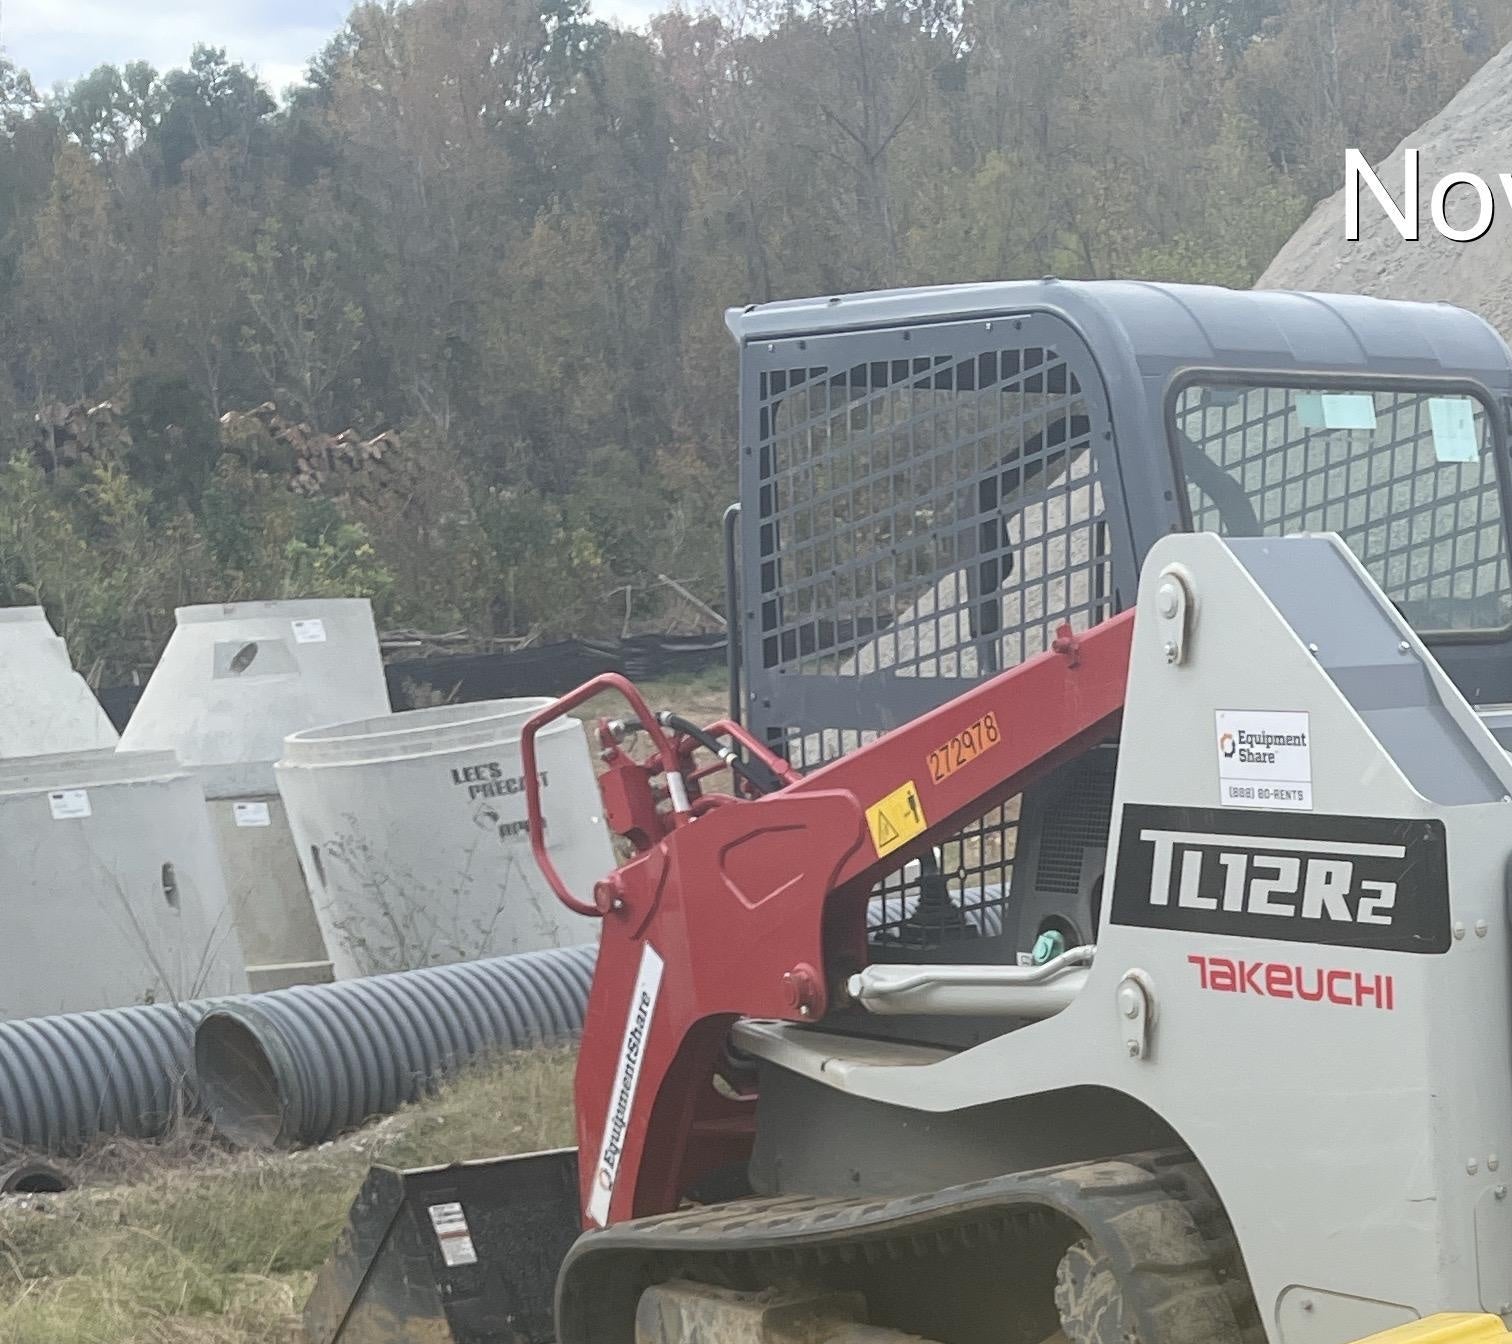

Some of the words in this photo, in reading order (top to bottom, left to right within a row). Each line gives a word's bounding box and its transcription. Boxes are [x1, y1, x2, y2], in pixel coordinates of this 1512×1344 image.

[930, 712, 998, 782] 272978
[1238, 730, 1307, 748] Equipment
[1238, 748, 1276, 764] Share
[602, 990, 650, 1168] EquipmentShare
